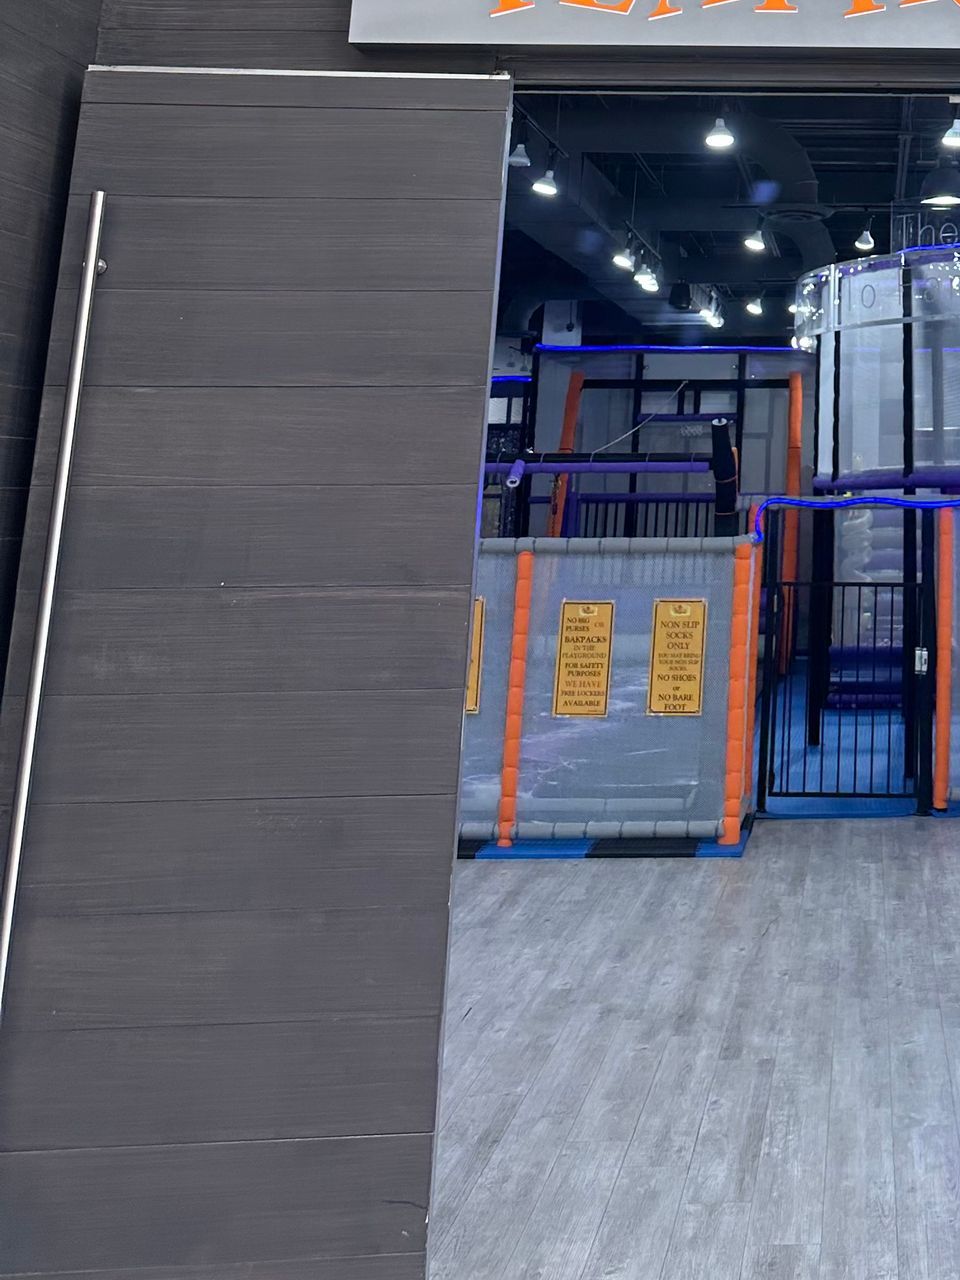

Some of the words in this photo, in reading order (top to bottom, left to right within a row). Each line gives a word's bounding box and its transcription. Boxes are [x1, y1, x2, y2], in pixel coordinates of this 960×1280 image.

[896, 213, 958, 250] The
[660, 621, 680, 629] NON
[682, 621, 700, 629] SLIP
[564, 635, 607, 643] BAKPACKS
[666, 631, 694, 639] SOCKS
[667, 641, 690, 650] ONLY
[568, 669, 601, 677] PURPOSES
[657, 673, 670, 682] NO
[671, 673, 697, 682] SHOES
[565, 680, 576, 688] WE
[579, 680, 601, 688] HAVE
[658, 693, 671, 702] NO
[672, 693, 694, 702] BARE
[664, 703, 687, 711] FOOT
